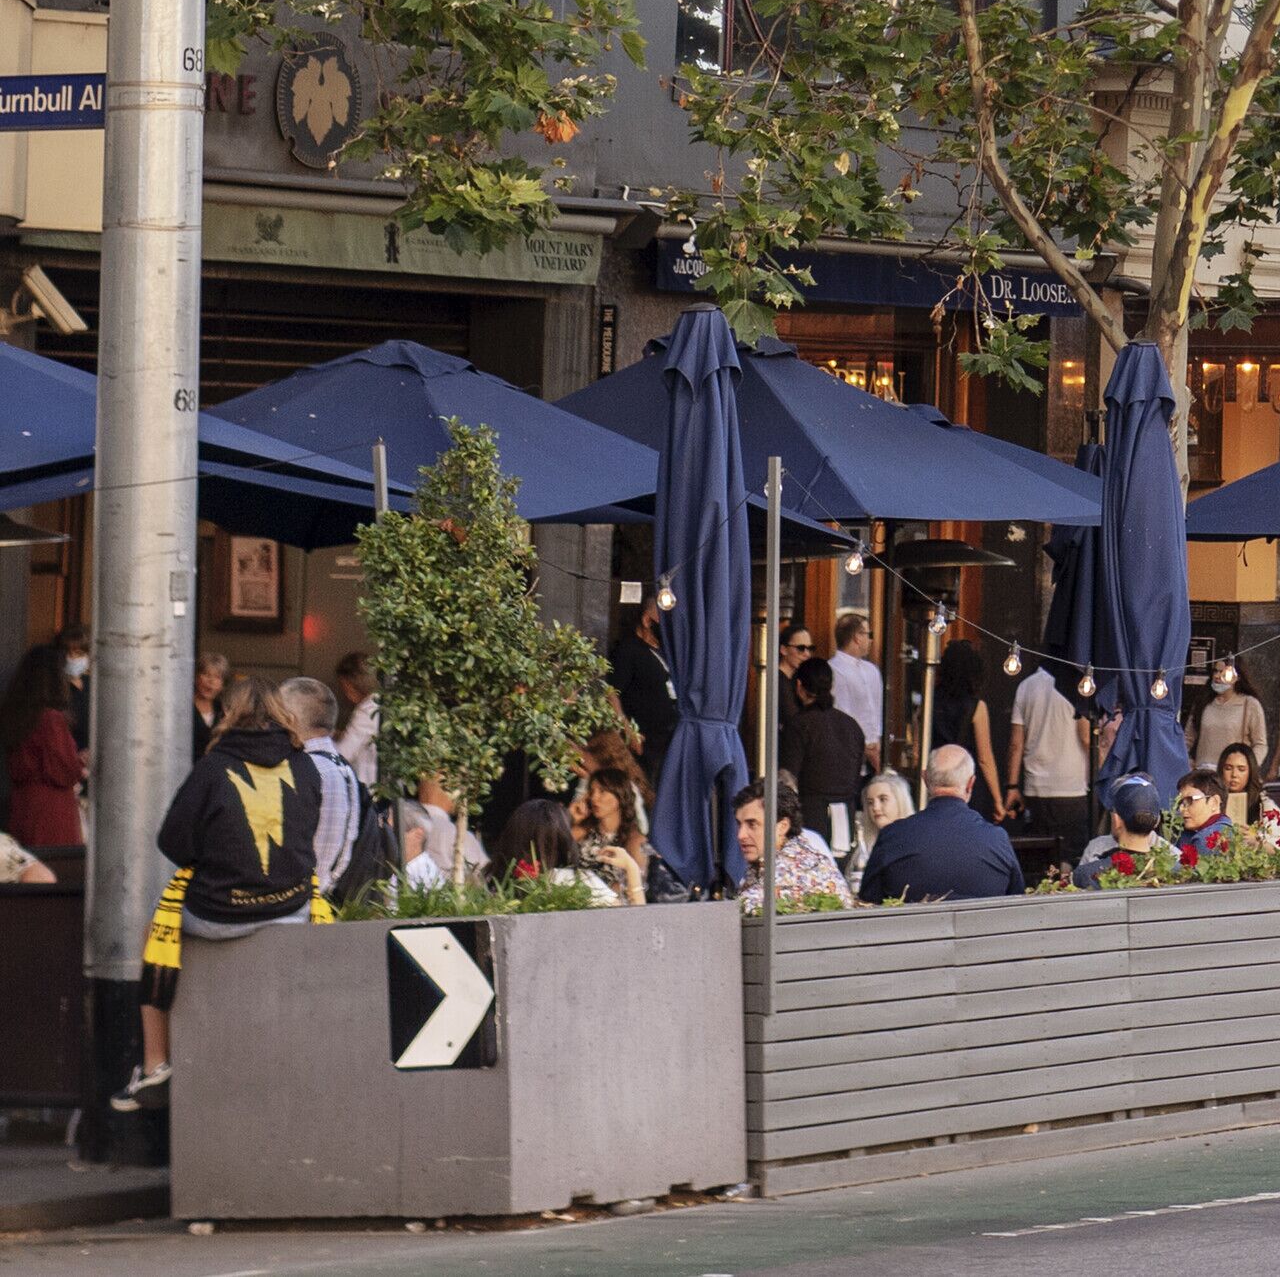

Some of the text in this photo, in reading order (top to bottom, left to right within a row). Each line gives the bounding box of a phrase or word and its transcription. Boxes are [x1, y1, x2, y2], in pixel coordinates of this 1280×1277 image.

[183, 47, 203, 72] 68
[0, 84, 103, 114] urnbull Al
[525, 239, 561, 254] MOUNT
[533, 255, 587, 272] VINEYARD
[673, 258, 706, 277] JACQU
[174, 388, 196, 412] 68
